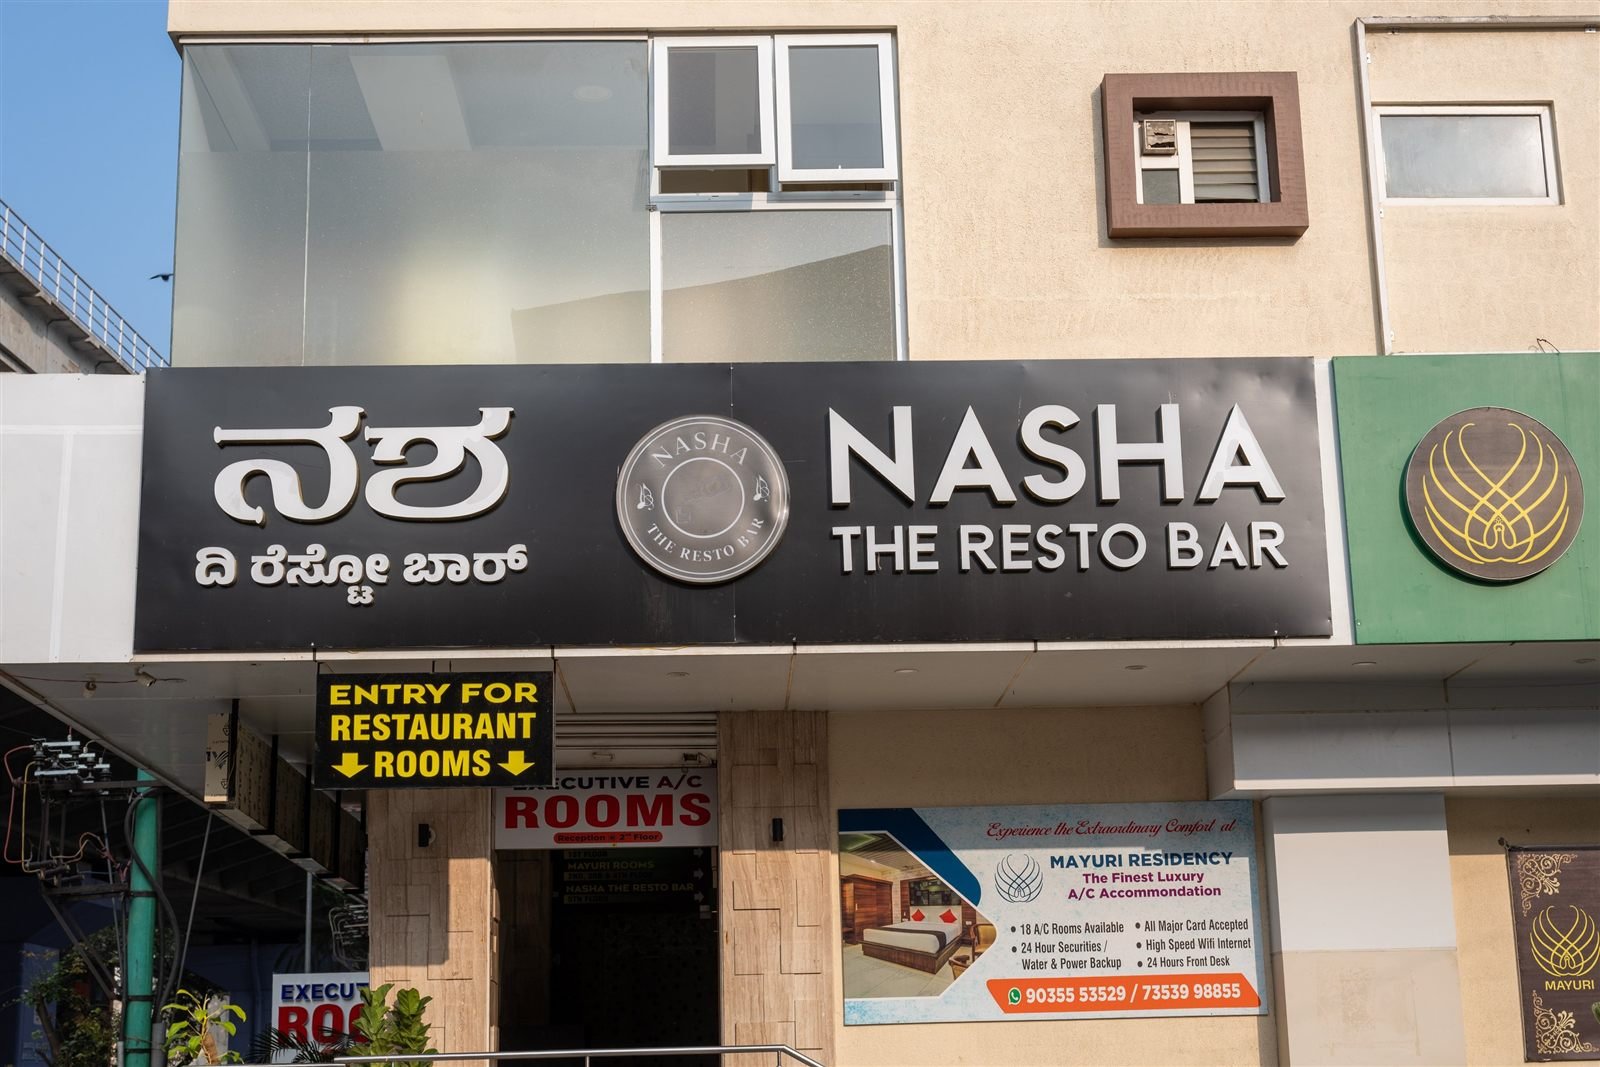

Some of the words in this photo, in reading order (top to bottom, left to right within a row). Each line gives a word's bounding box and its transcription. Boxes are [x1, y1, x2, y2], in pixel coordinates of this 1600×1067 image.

[651, 431, 748, 467] NASHA
[828, 403, 1286, 506] NASHA
[213, 405, 516, 527] ನಶ
[647, 523, 673, 553] THE
[680, 544, 735, 562] RESTO
[738, 518, 764, 548] BAR
[832, 525, 939, 573] THE
[960, 522, 1147, 572] RESTO
[1168, 521, 1289, 569] BAR
[195, 546, 237, 587] ದಿ
[250, 544, 389, 606] ರೆಸ್ಟೋ
[403, 543, 528, 586] ಬಾರ್
[330, 683, 450, 706] ENTRY
[462, 682, 538, 704] FOR
[331, 712, 536, 741] RESTAURANT
[374, 750, 491, 778] ROOMS
[513, 776, 650, 790] CUTIVE
[657, 775, 703, 789] A/C
[505, 792, 711, 829] ROOMS
[987, 821, 1052, 838] Experience
[1054, 821, 1073, 836] the
[1075, 820, 1162, 838] Extraordinary
[1165, 818, 1216, 837] Comfort
[1220, 818, 1237, 832] at
[557, 834, 606, 843] Reception
[634, 833, 658, 841] Floor
[567, 861, 610, 870] MAYURI
[614, 860, 656, 869] ROOMS
[1050, 854, 1123, 869] MAYURI
[1129, 851, 1233, 867] RESIDENCY
[1082, 873, 1109, 885] The
[1112, 872, 1154, 884] Finest
[1157, 871, 1204, 886] Luxury
[566, 884, 605, 893] NASHA
[608, 883, 629, 892] THE
[633, 883, 669, 892] RESTO
[672, 882, 694, 891] BAR
[1068, 887, 1096, 900] A/C
[1099, 885, 1222, 899] Accommondation
[1020, 924, 1032, 936] 18
[1034, 924, 1049, 936] A/C
[1051, 923, 1082, 935] Rooms
[1084, 921, 1124, 935] Available
[1144, 920, 1156, 932] All
[1158, 920, 1184, 934] Major
[1186, 919, 1207, 932] Card
[1209, 919, 1249, 934] Accepted
[1021, 941, 1033, 954] 24
[1035, 942, 1056, 954] Hour
[1058, 940, 1102, 953] Securities
[1146, 937, 1165, 953] High
[1168, 938, 1195, 953] Speed
[1196, 938, 1215, 951] Wifi
[1217, 937, 1251, 951] Internet
[1022, 958, 1048, 970] Water
[1050, 958, 1058, 970] &
[1060, 958, 1088, 970] Power
[1089, 957, 1122, 971] Backup
[1147, 957, 1158, 968] 24
[1160, 957, 1184, 968] Hours
[1186, 956, 1208, 968] Front
[1210, 955, 1230, 967] Desk
[1026, 988, 1075, 1004] 90355
[1079, 987, 1126, 1003] 53529
[1142, 984, 1190, 1001] 73539
[1194, 983, 1241, 999] 98855
[1545, 979, 1595, 991] MAYURI
